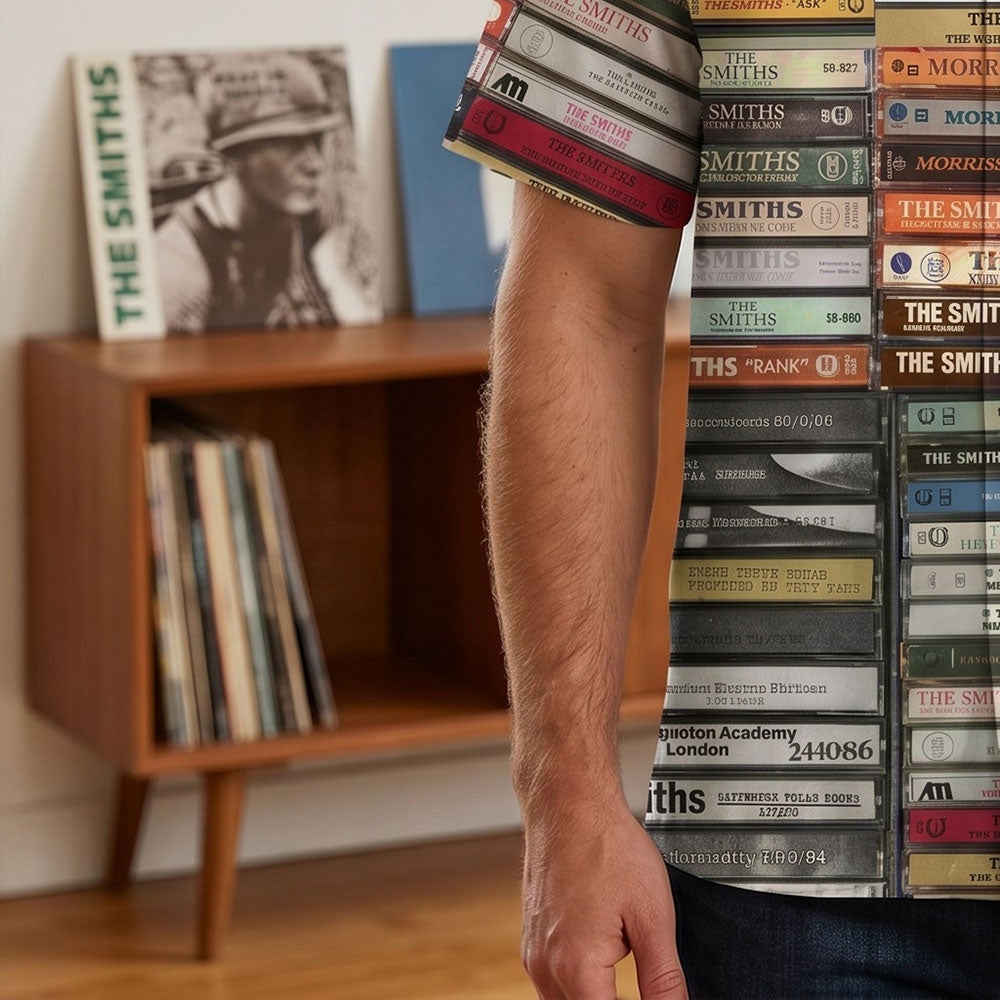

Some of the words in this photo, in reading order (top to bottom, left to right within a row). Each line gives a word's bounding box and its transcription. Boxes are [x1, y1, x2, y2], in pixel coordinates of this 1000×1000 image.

[704, 0, 783, 10] THESMITHS
[945, 34, 971, 44] THE
[725, 53, 756, 64] THE
[703, 66, 778, 80] SMITHS
[709, 104, 785, 120] SMITHS
[88, 64, 134, 229] SMITHS
[700, 151, 800, 172] SMITHS
[697, 201, 803, 219] SMITHS
[899, 201, 946, 219] THE
[695, 250, 800, 268] SMITHS
[109, 244, 143, 326] THE
[728, 302, 757, 311] THE
[904, 302, 942, 324] THE
[709, 313, 777, 326] SMITHS
[691, 357, 737, 377] THS
[896, 351, 934, 373] THE
[923, 452, 952, 465] THE
[917, 690, 955, 706] THE
[719, 726, 797, 743] Academy
[666, 743, 729, 757] London
[788, 739, 874, 762] 244086
